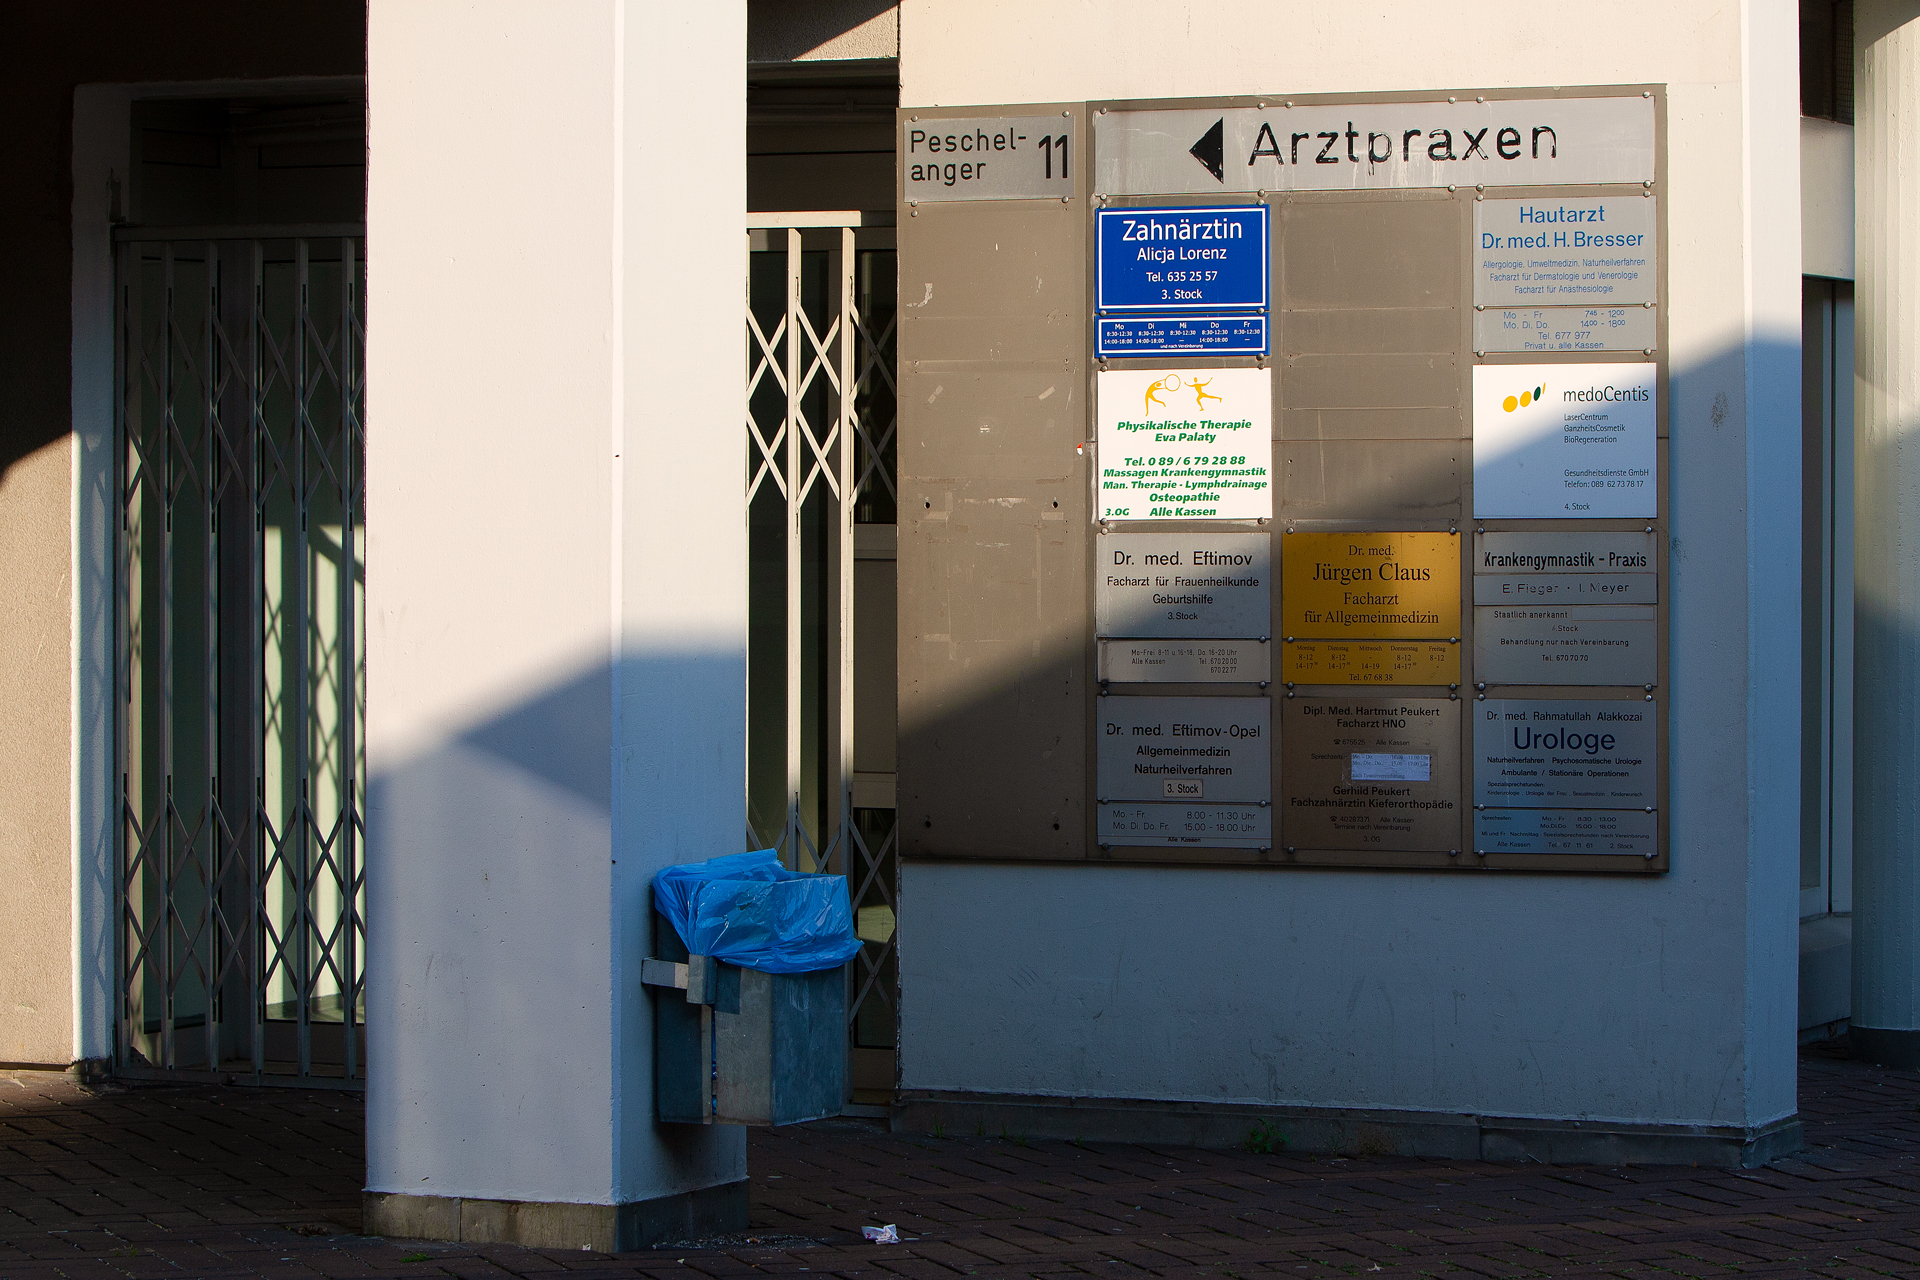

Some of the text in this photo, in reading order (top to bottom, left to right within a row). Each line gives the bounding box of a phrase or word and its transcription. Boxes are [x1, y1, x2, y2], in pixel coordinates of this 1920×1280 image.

[911, 127, 1027, 153] Peschel-
[1247, 121, 1557, 176] Arztpraxen
[1038, 134, 1068, 179] 11
[911, 162, 986, 187] anger
[1520, 206, 1605, 223] Hautarzt
[1122, 218, 1242, 241] Zahnärztin
[1482, 231, 1643, 249] Dr. med. H. Bresser
[1137, 247, 1227, 264] Alicja Lorenz
[1582, 258, 1645, 267] Naturheilverfahren
[1146, 271, 1217, 282] Tel. 635 25 57
[1490, 273, 1519, 281] Facharzt
[1534, 273, 1580, 282] Dermatologie
[1597, 271, 1638, 281] Venerologie
[1162, 289, 1202, 299] 3. Stock
[1515, 284, 1613, 294] Facharzt für Anästhesiologie
[1563, 386, 1649, 402] medoCentis
[1117, 419, 1252, 432] Physikalische Therapie
[1564, 424, 1625, 432] GanzheitsCosmetik
[1155, 432, 1216, 443] Eva Palaty
[1564, 436, 1617, 445] BioRegeneration
[1104, 467, 1266, 479] Massagen Krankengymnastik
[1564, 469, 1626, 477] Gesundheitsdienste
[1103, 480, 1267, 490] Man. Therapie Lymphdrainage
[1149, 492, 1220, 503] Osteopathie
[1105, 507, 1216, 516] 3.OG Alle Kassen
[1349, 545, 1394, 556] Dr. med.
[1114, 551, 1252, 565] Dr. med. Eftimov
[1485, 552, 1647, 570] Krankengymnastik Praxis
[1313, 563, 1430, 585] Jürgen Claus
[1108, 576, 1259, 586] Facharzt für Frauenheilkunde
[1503, 584, 1513, 593] E.
[1590, 583, 1629, 594] Meyer
[1153, 594, 1213, 604] Geburtshilfe
[1344, 592, 1399, 605] Facharzt
[1304, 611, 1439, 626] für Allgemeinmedizin
[1580, 639, 1629, 647] Vereinbarung
[1304, 706, 1440, 717] Dipl. Med. Hartmut Peukert
[1487, 711, 1643, 722] Dr. med. Rahmatullah Alakkozai
[1337, 719, 1406, 728] Facharzt HNO
[1106, 723, 1124, 735] Dr.
[1133, 724, 1164, 736] med.
[1514, 727, 1615, 754] Urologe
[1137, 746, 1230, 757] Allgemeinmedizin
[1552, 757, 1611, 765] Psychosomatische
[1135, 764, 1232, 775] Naturheilverfahren
[1587, 770, 1629, 778] Operationen
[1168, 784, 1198, 793] 3. Stock
[1333, 786, 1410, 796] Gerhild Peukert
[1291, 798, 1453, 810] Fachzahnärztin Kieferorthopädie
[1184, 823, 1206, 831] 15.00
[1242, 824, 1255, 832] Uhr
